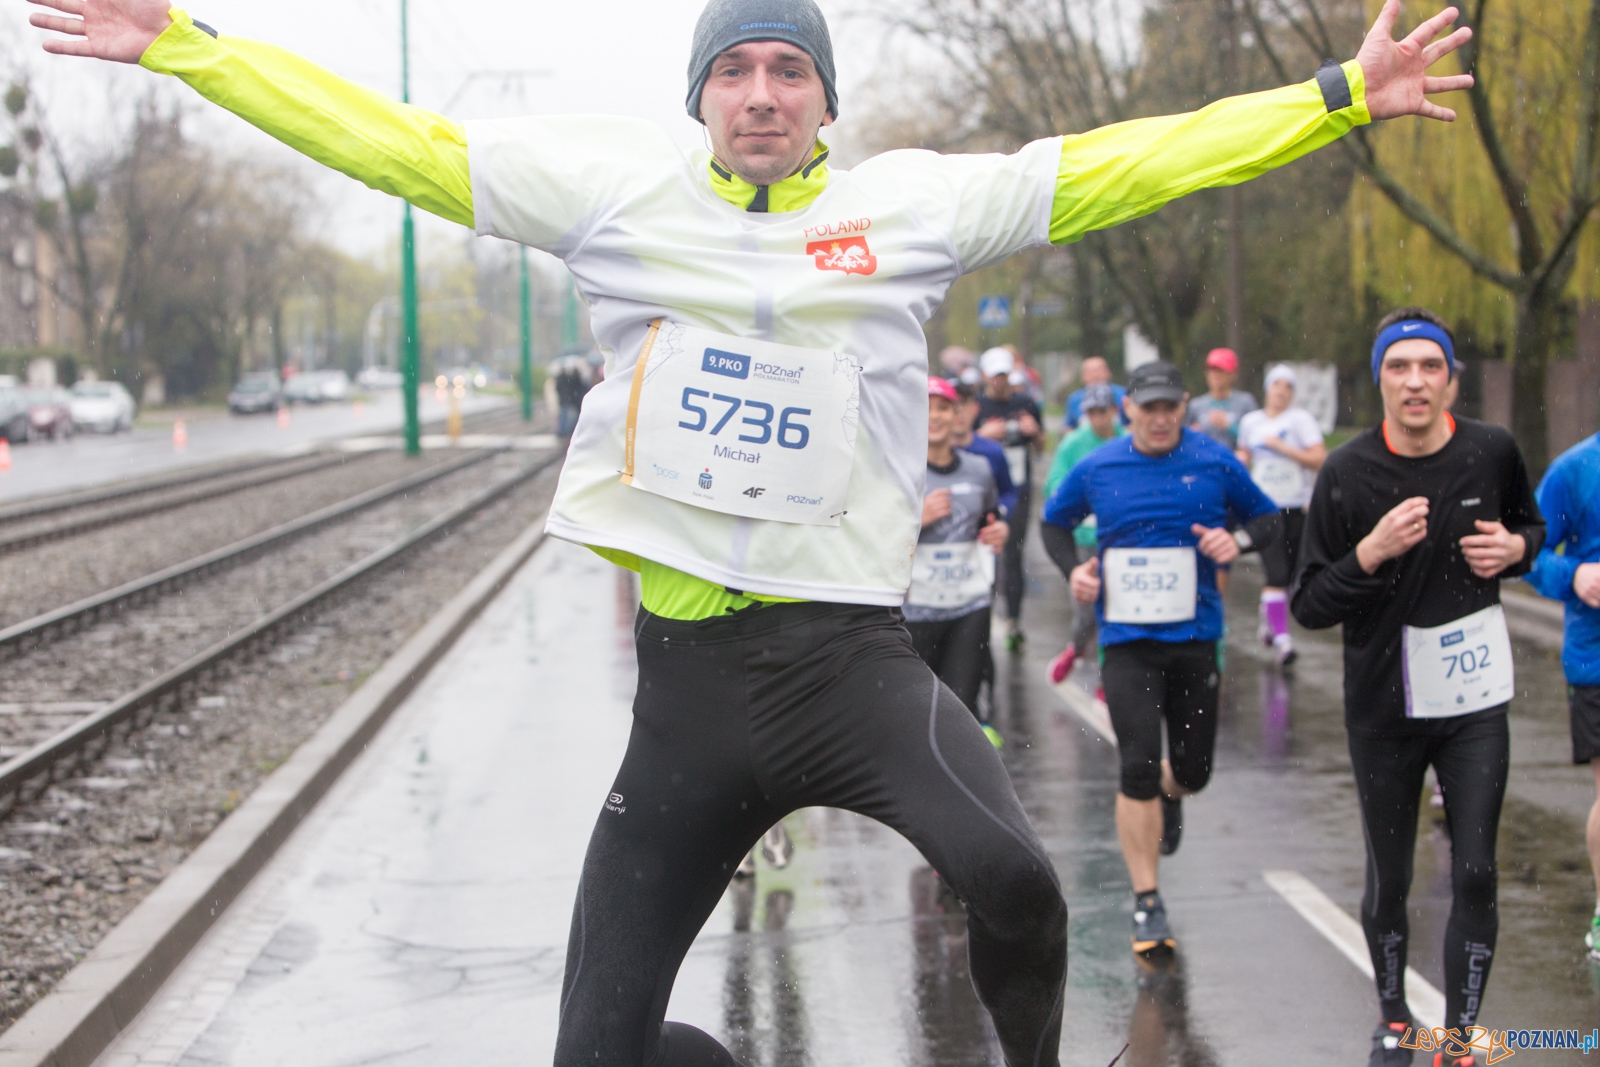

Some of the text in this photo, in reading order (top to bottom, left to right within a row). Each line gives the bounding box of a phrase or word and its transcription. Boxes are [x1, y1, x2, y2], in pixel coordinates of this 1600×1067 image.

[740, 22, 798, 32] GRUNDIG
[803, 217, 872, 238] POLAND
[678, 386, 812, 450] 5736
[713, 444, 762, 464] Michał
[742, 486, 766, 499] 4F
[1121, 572, 1179, 592] 5632
[1442, 644, 1491, 679] 702
